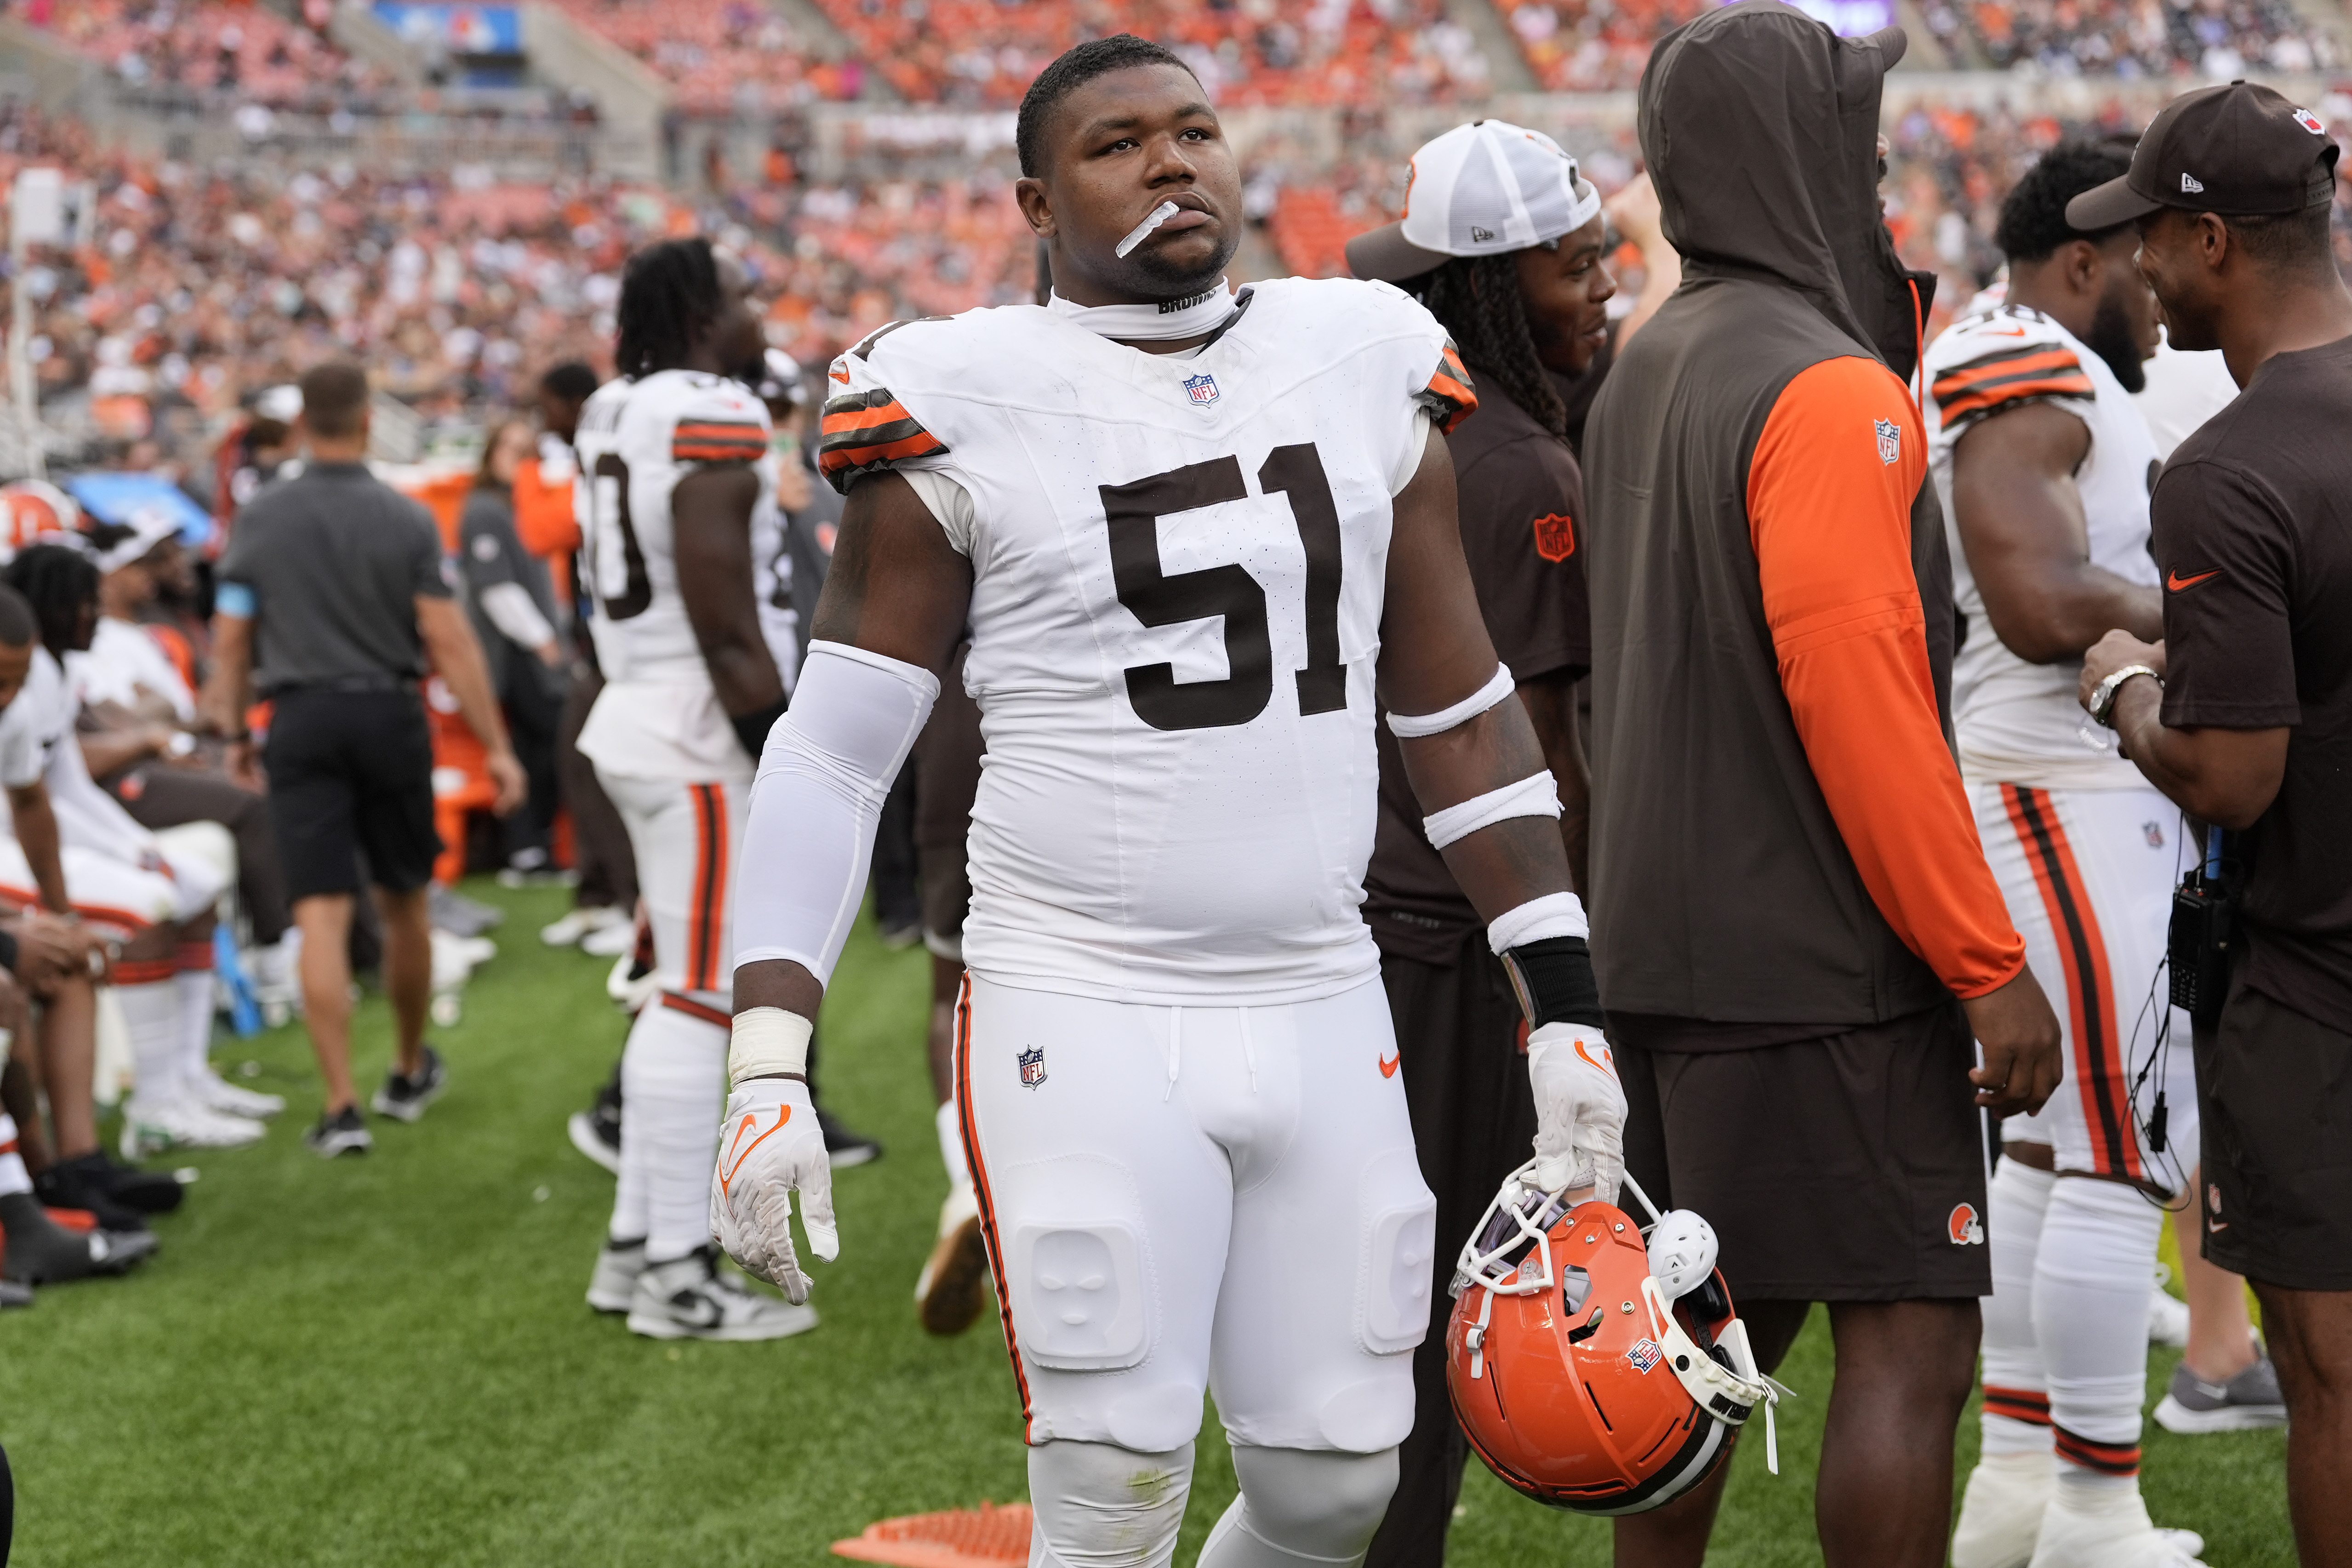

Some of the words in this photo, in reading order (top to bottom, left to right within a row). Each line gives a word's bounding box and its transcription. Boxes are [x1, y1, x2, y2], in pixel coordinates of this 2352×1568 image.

[1191, 385, 1216, 400] NFL
[1879, 436, 1896, 458] NFL
[1098, 442, 1347, 731] 51
[1022, 1063, 1042, 1081] NFL
[1638, 1342, 1658, 1363] NFL
